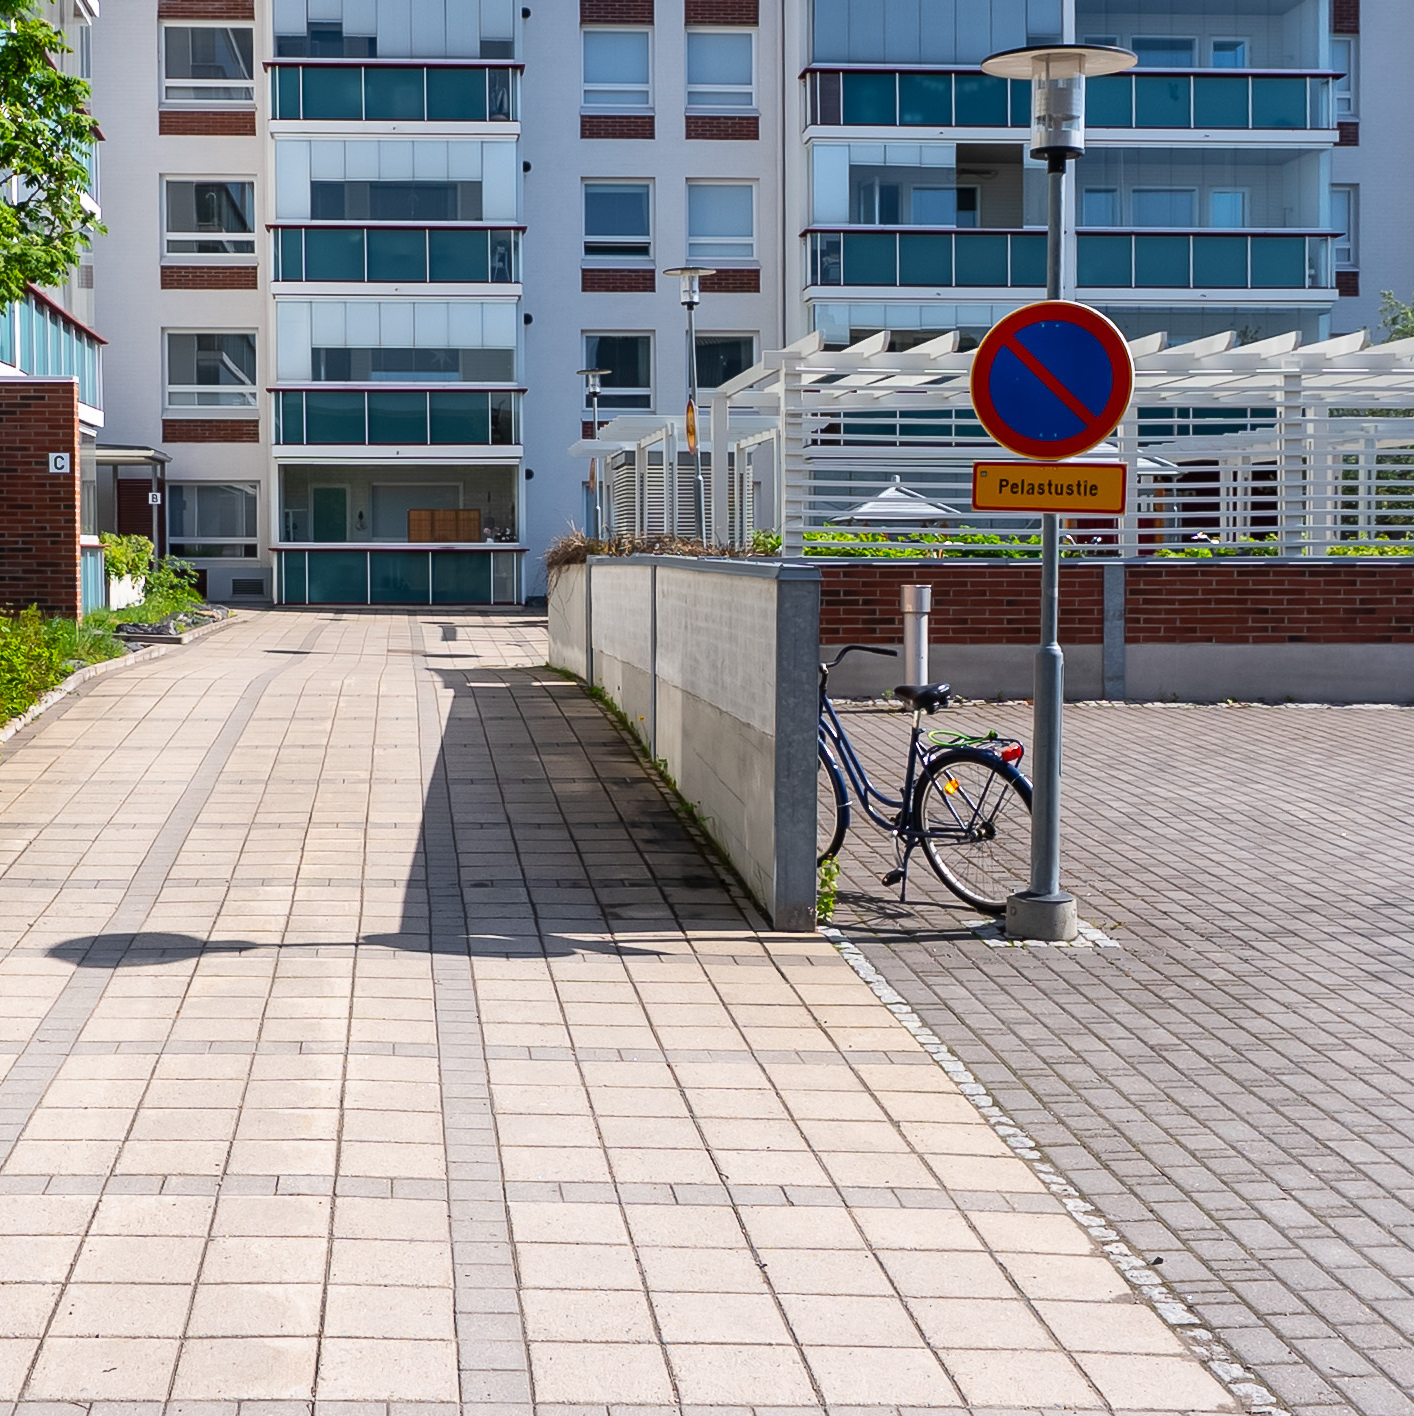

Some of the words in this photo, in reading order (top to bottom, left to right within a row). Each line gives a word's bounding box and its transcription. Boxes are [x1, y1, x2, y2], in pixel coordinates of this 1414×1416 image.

[53, 455, 65, 471] C
[998, 477, 1099, 497] Pelastustie
[151, 493, 158, 503] B
